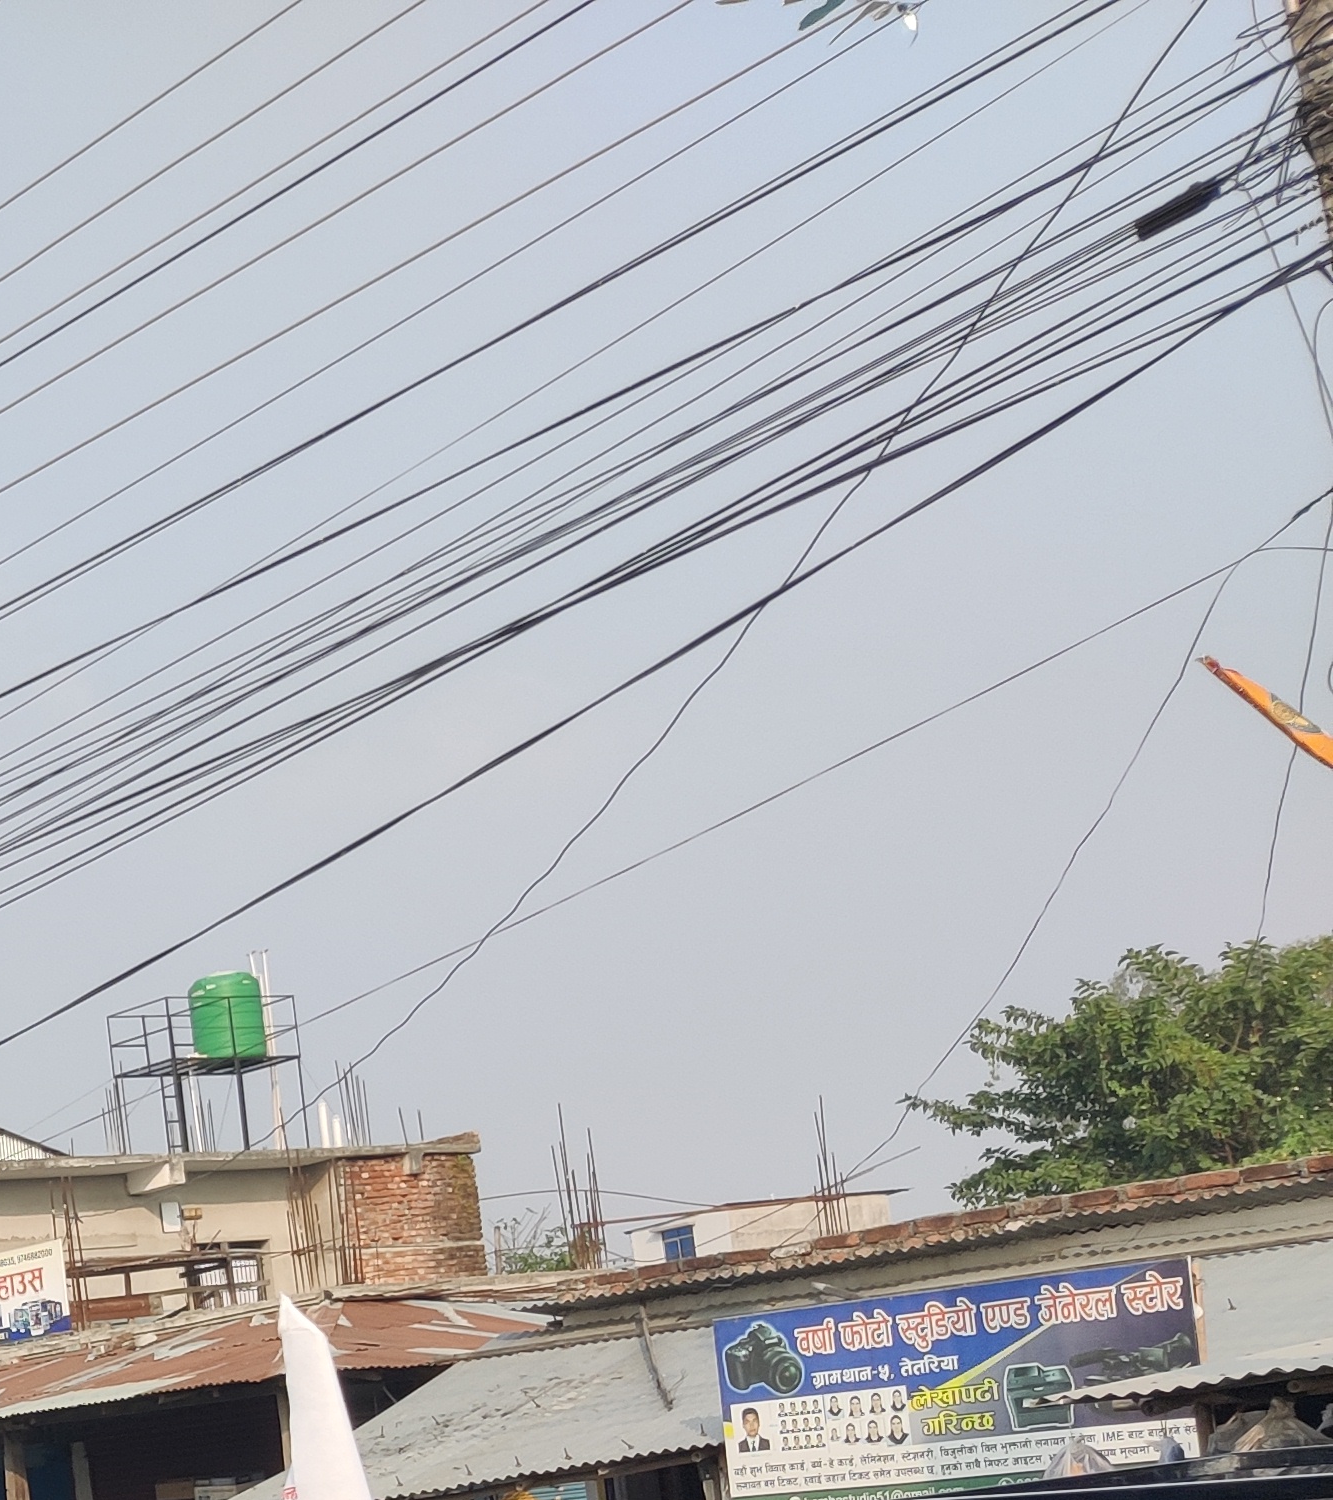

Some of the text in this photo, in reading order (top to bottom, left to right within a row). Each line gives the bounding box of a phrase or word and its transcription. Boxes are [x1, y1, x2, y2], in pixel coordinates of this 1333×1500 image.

[795, 1271, 1183, 1356] वर्षा फोटो स्टुडियो एण्ड जेनेरल स्टोर
[921, 1410, 995, 1436] गरिन्छ
[1102, 1430, 1126, 1442] IME
